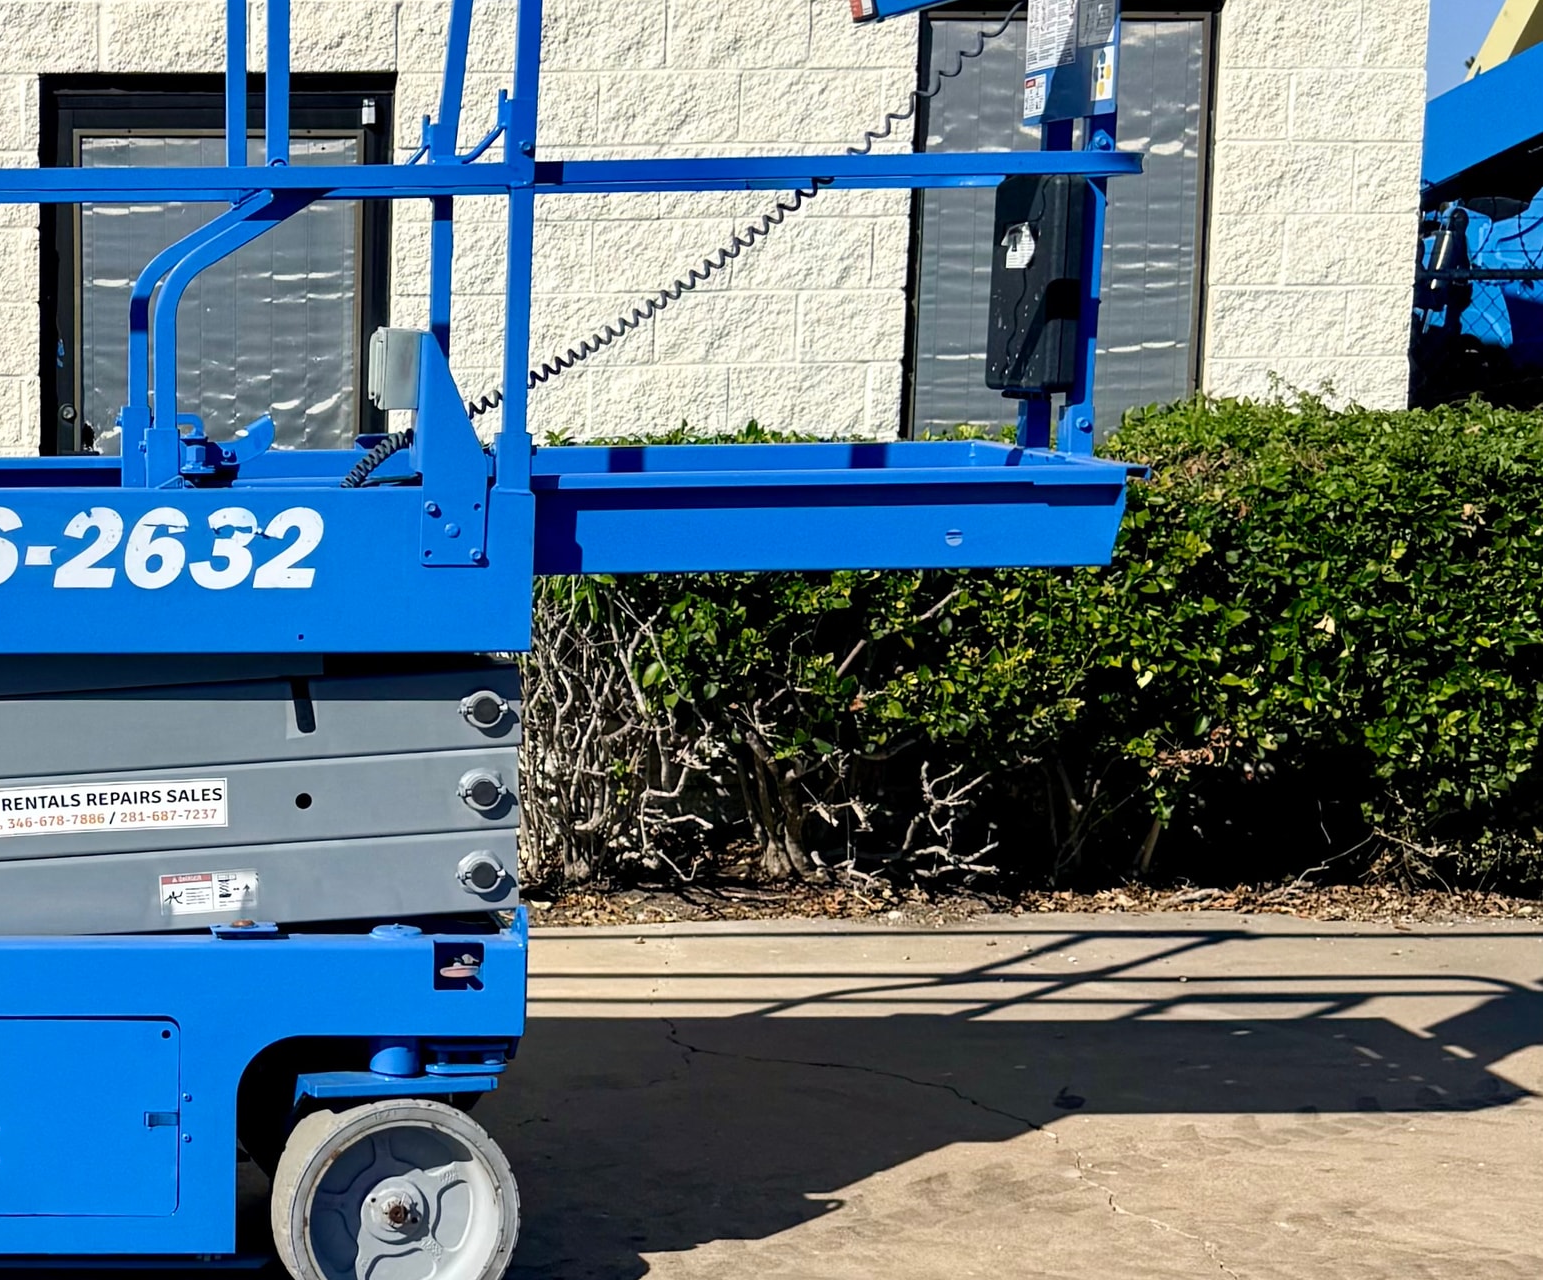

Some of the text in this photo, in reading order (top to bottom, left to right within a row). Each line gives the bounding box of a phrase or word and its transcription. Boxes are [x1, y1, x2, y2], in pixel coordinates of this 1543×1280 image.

[1, 787, 223, 812] RENTALS REPAIRS SALES
[7, 813, 105, 829] 346-678-7886
[109, 811, 116, 825] /
[120, 808, 217, 823] 281-687-7237
